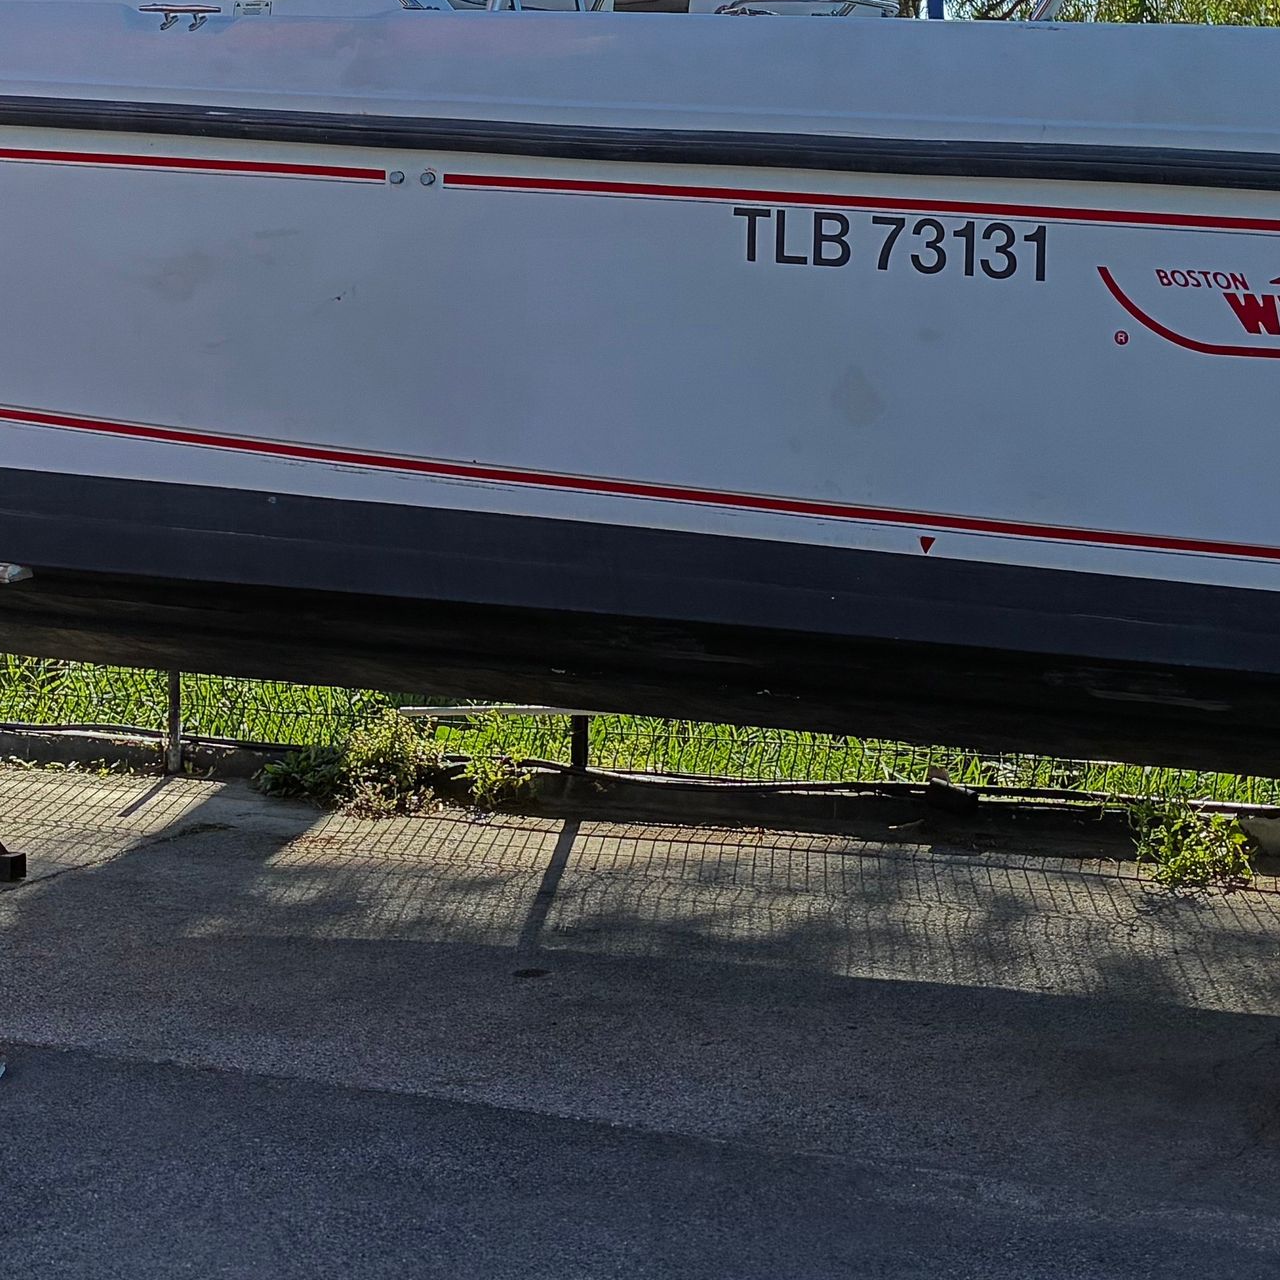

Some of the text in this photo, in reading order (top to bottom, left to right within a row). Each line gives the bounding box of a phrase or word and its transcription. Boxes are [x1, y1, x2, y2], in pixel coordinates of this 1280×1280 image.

[733, 207, 1046, 282] TLB 73131
[1155, 268, 1250, 291] BOSTON
